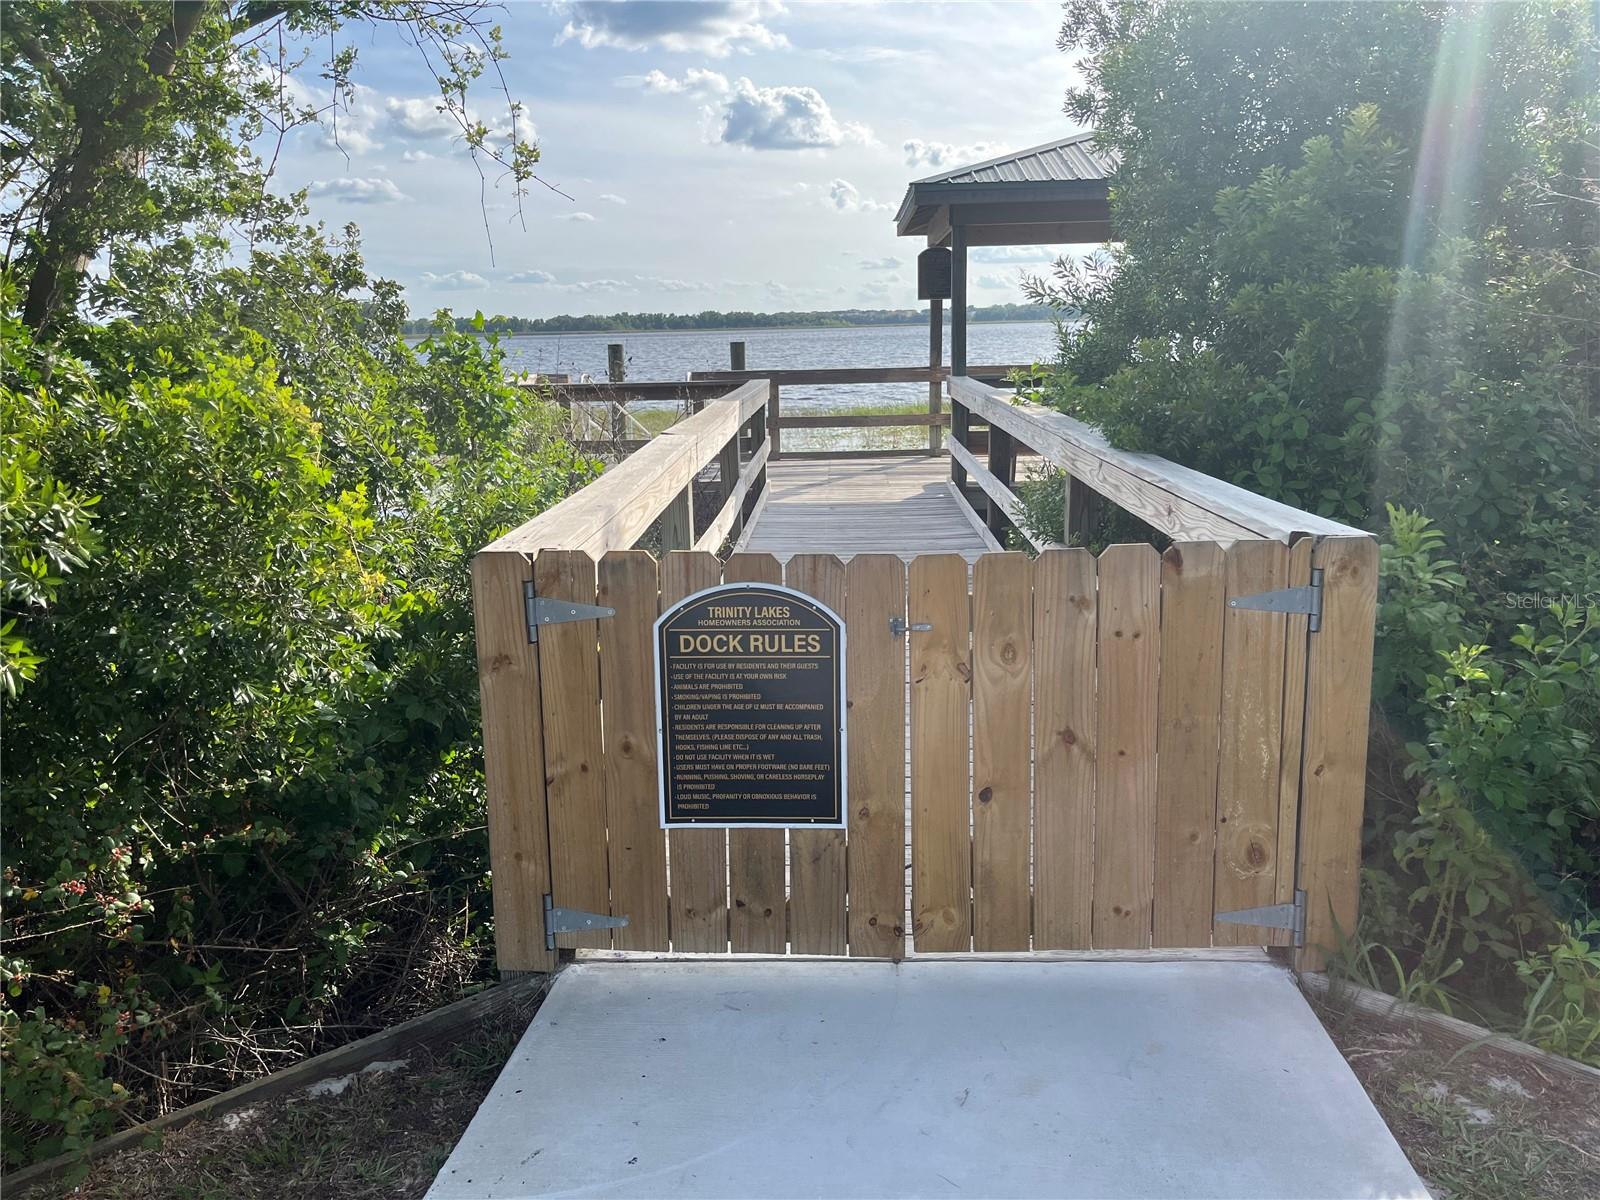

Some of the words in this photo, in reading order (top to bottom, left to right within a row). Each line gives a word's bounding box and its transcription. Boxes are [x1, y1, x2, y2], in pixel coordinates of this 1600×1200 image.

[708, 607, 751, 617] TRINITY
[755, 607, 790, 617] LAKES
[680, 635, 743, 652] DOCK
[750, 635, 820, 652] RULES
